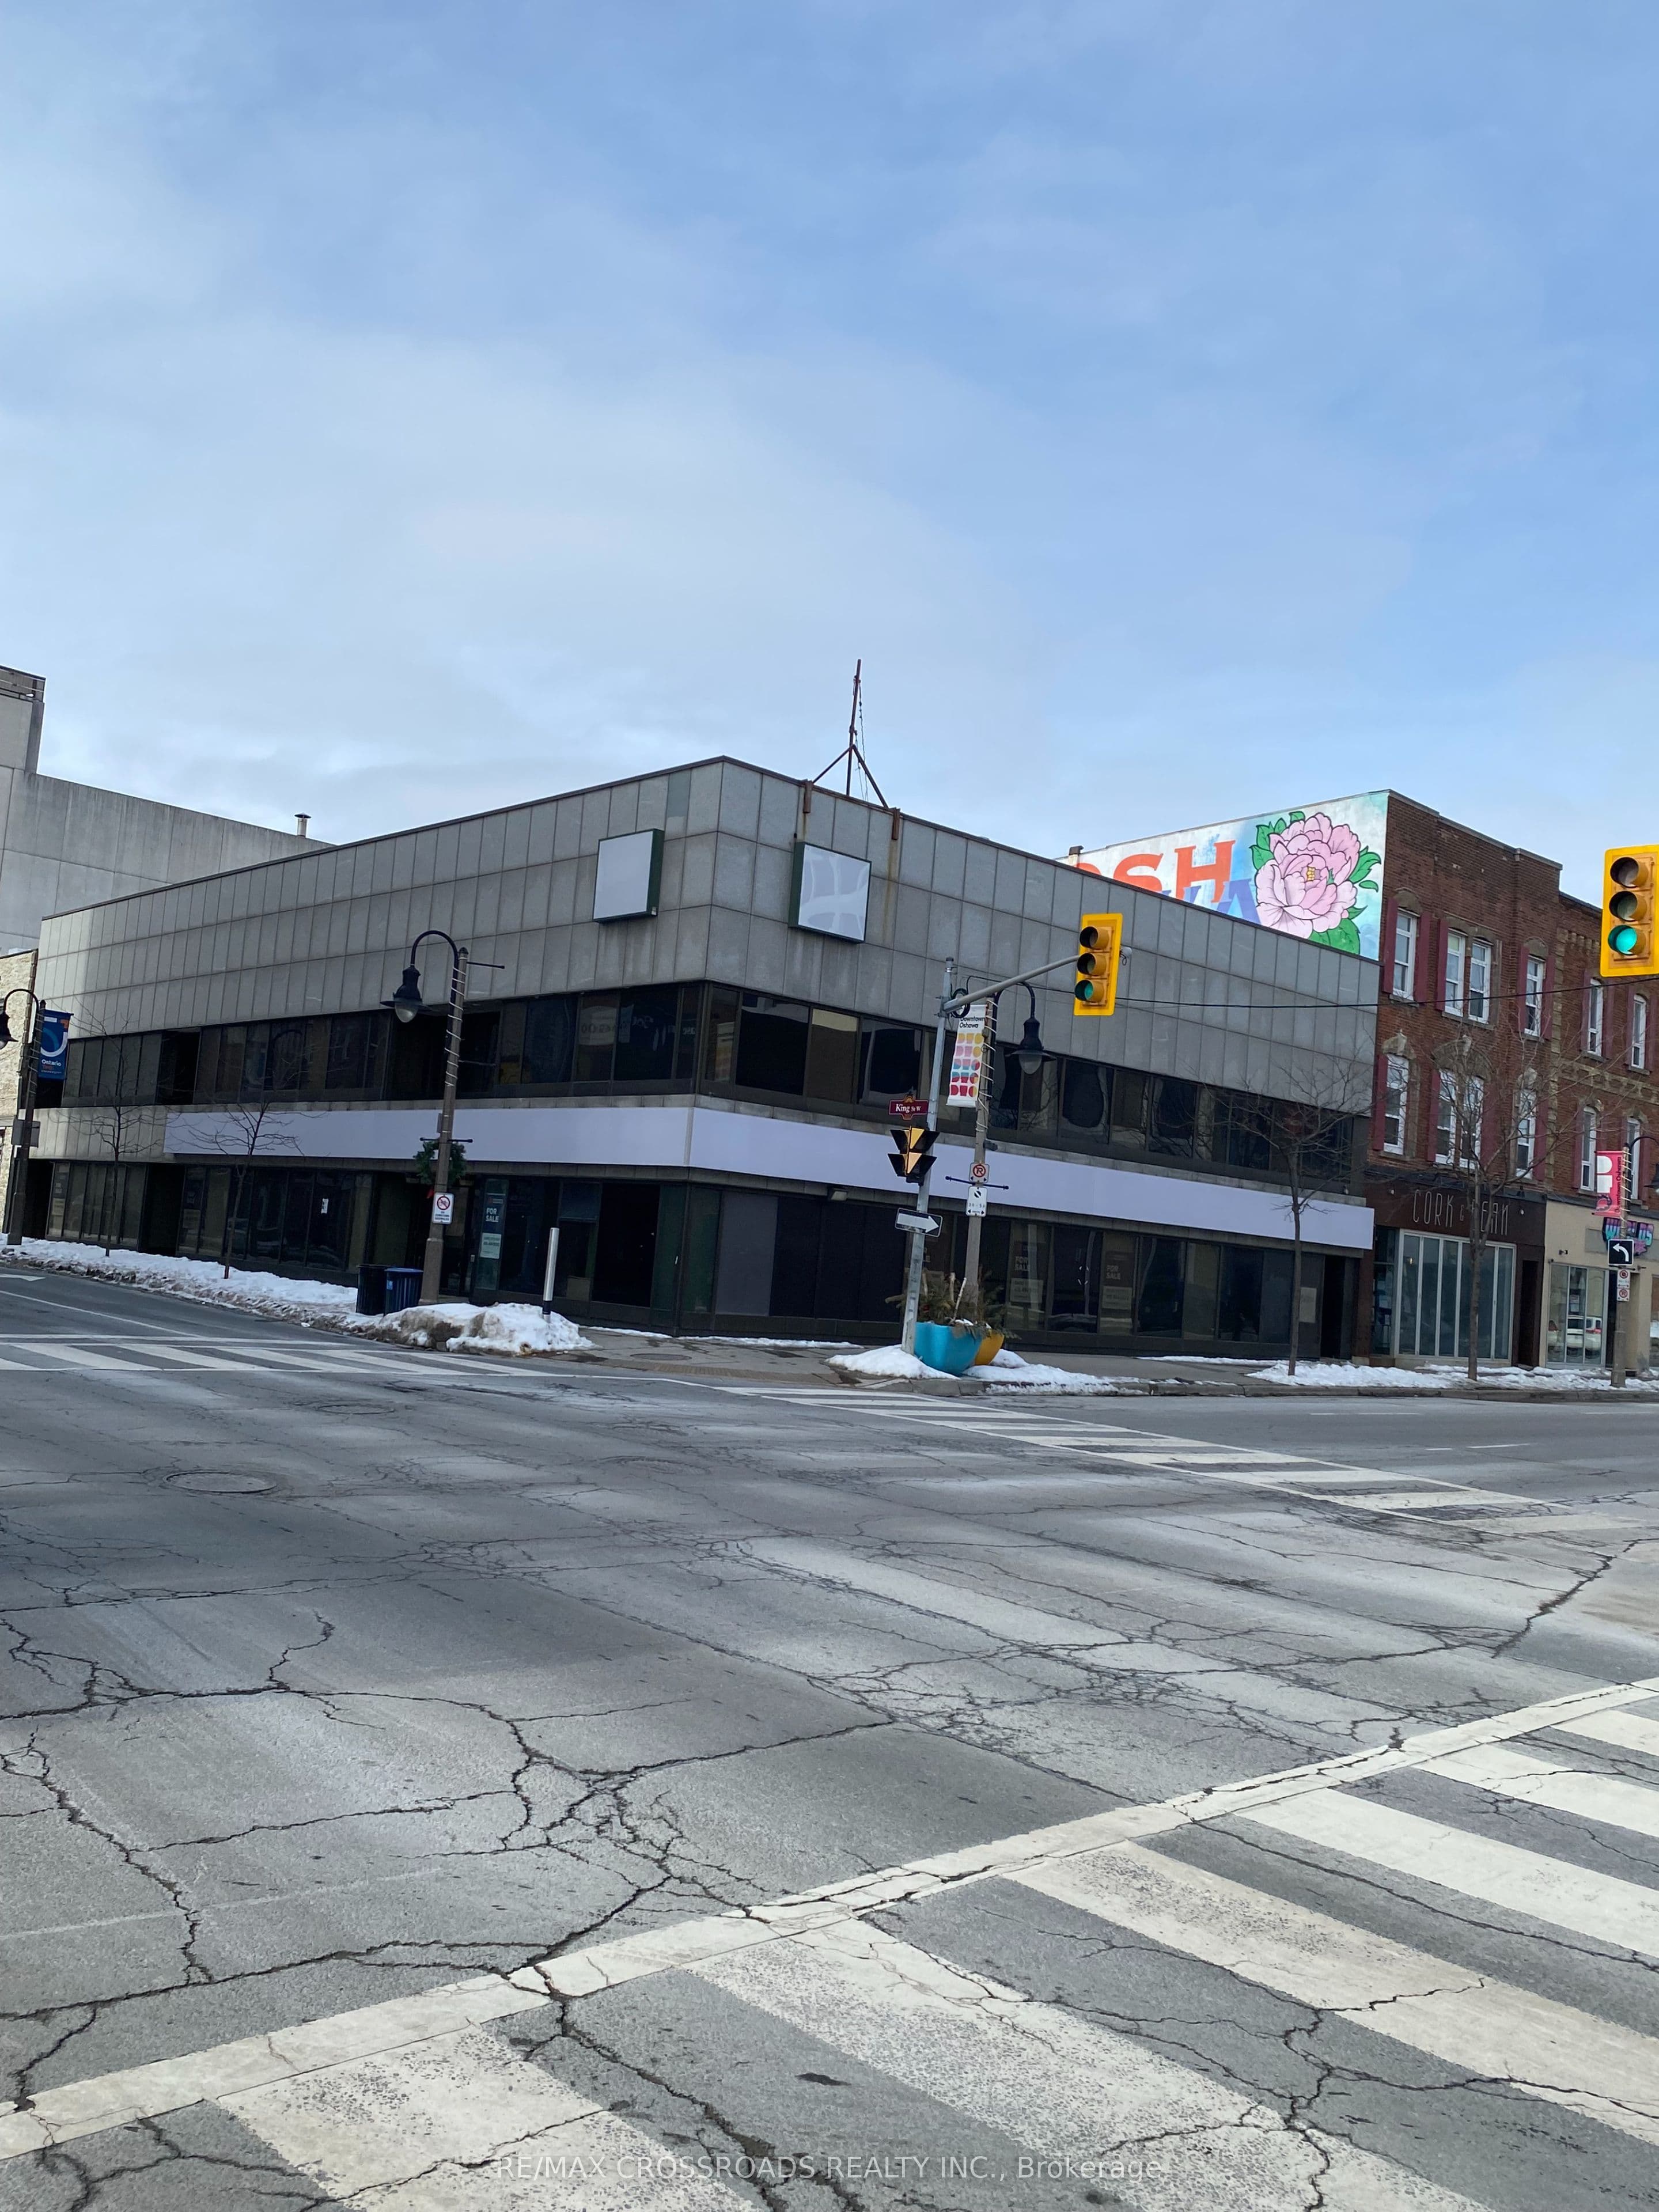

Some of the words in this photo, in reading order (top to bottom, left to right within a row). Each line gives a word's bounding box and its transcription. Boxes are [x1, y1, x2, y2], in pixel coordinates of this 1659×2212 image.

[1076, 840, 1236, 903] SH
[41, 1059, 62, 1067] Ontario
[895, 1104, 910, 1113] King
[1412, 1189, 1454, 1228] CORK
[1471, 1199, 1509, 1236] EAN
[1015, 1256, 1029, 1264] FOR
[1105, 1272, 1121, 1280] SALE
